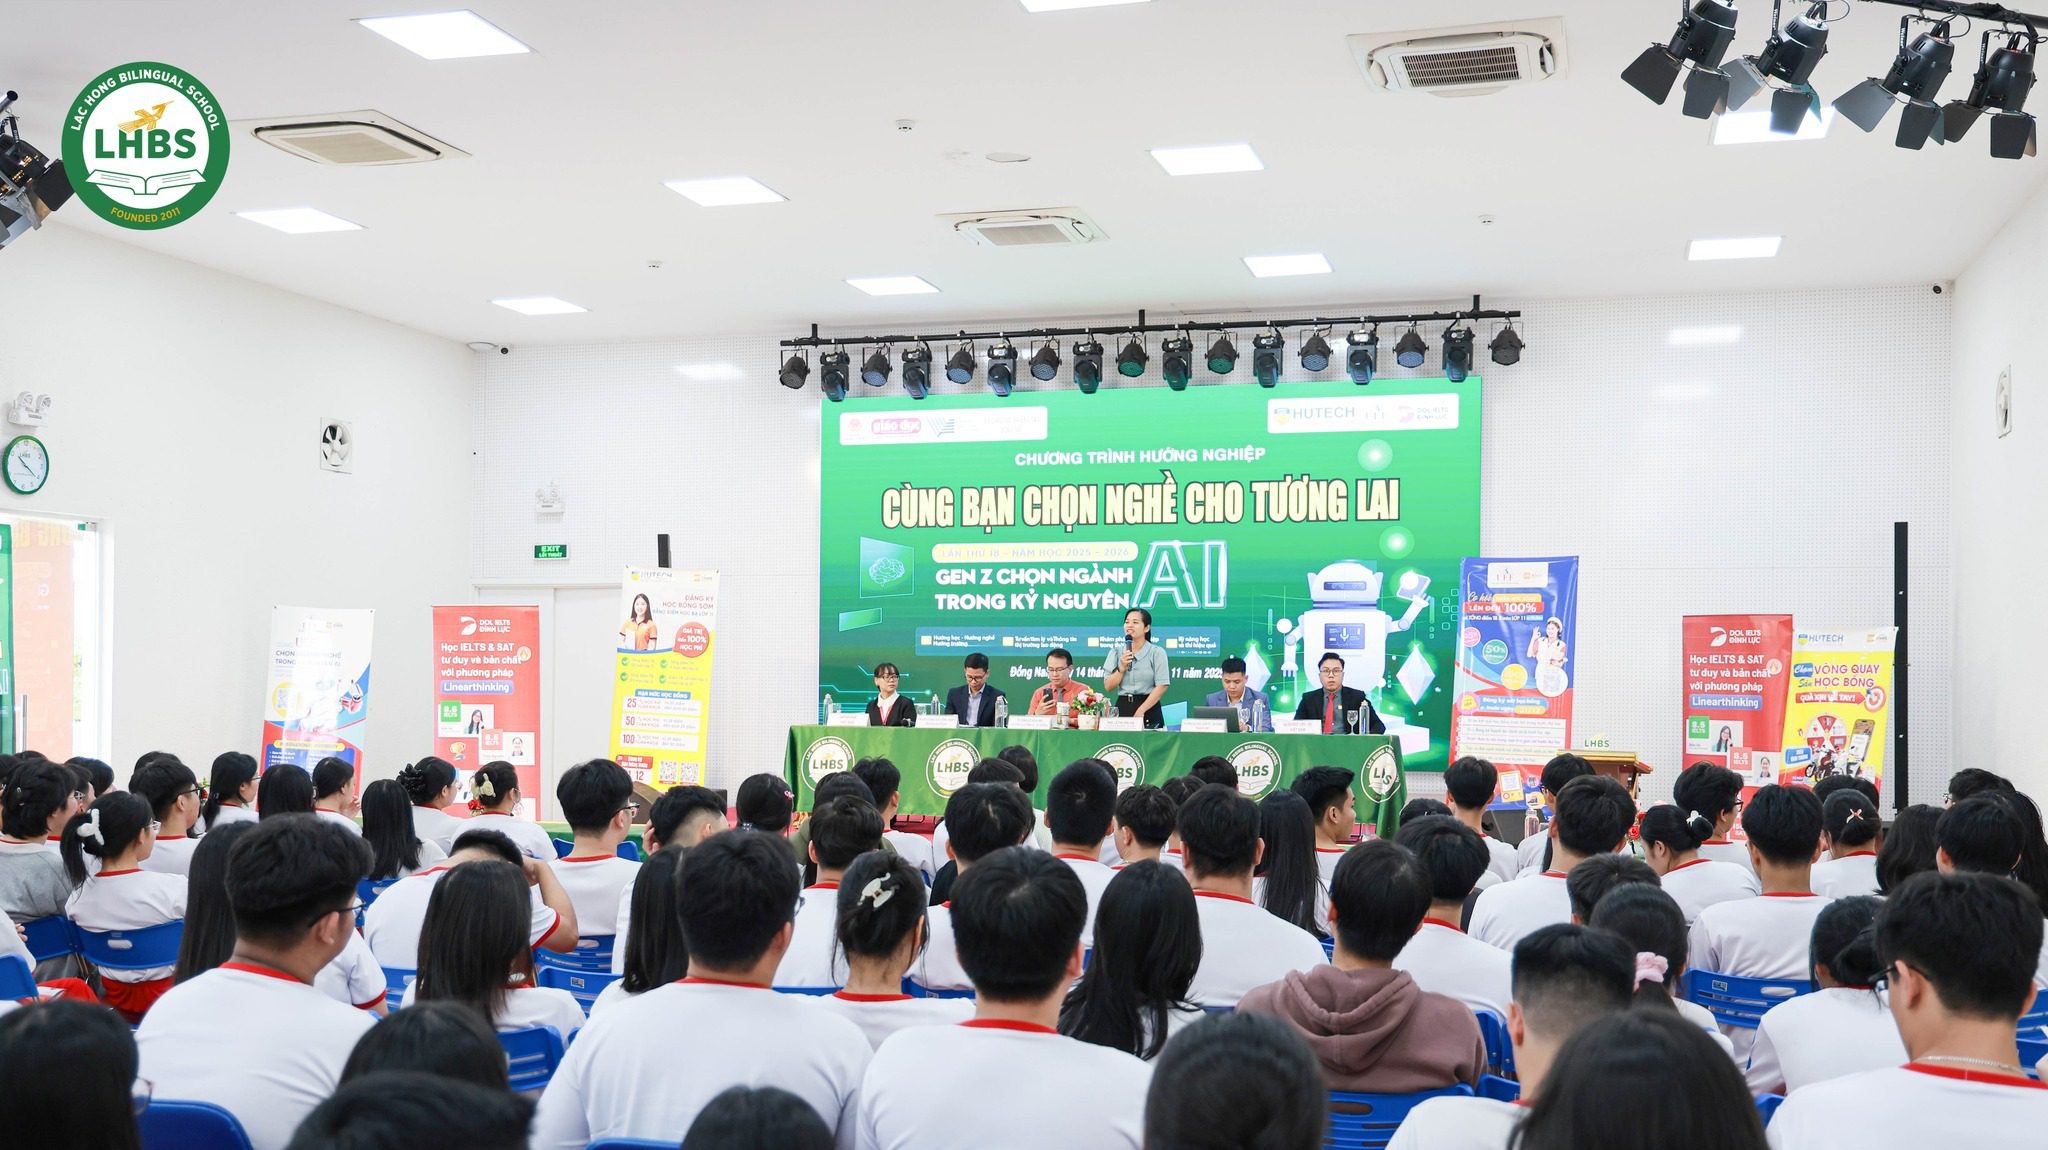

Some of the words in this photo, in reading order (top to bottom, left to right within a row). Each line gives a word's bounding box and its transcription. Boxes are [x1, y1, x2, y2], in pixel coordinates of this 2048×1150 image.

[1293, 406, 1356, 420] HUTECH
[1015, 450, 1082, 466] CHƯƠNG
[1088, 448, 1135, 464] TRÌNH
[1140, 446, 1198, 463] HƯỚNG
[1202, 444, 1266, 462] NGHIỆP
[882, 481, 954, 528] CÙNG
[961, 486, 1016, 534] BẠN
[1022, 484, 1098, 533] CHỌN
[1104, 470, 1178, 526] NGHỀ
[1184, 481, 1244, 524] CHO
[1250, 474, 1348, 523] TƯƠNG
[1356, 478, 1400, 521] LAI
[1012, 547, 1036, 557] NĂM
[1040, 548, 1062, 558] HỌC
[1066, 548, 1091, 556] 2025
[1104, 548, 1129, 556] 2026
[936, 568, 976, 585] GEN
[980, 568, 992, 584] Z
[996, 568, 1056, 586] CHỌN
[1060, 562, 1133, 584] NGÀNH
[1130, 540, 1228, 609] AI
[934, 594, 1006, 610] TRONG
[1010, 588, 1040, 610] KỶ
[1044, 588, 1130, 610] NGUYÊN
[1504, 603, 1536, 612] 100%
[1809, 634, 1844, 642] HUTECH
[441, 643, 458, 653] Học
[460, 643, 487, 651] IELTS
[488, 643, 495, 651] &
[497, 643, 514, 651] SAT
[442, 656, 451, 664] tư
[452, 656, 469, 665] duy
[471, 656, 482, 664] và
[483, 655, 500, 664] bản
[502, 655, 521, 664] chất
[1690, 655, 1707, 665] Học
[1710, 655, 1735, 663] IELTS
[1738, 655, 1745, 663] &
[1748, 655, 1764, 663] SAT
[441, 668, 454, 676] với
[456, 668, 490, 678] phương
[492, 668, 514, 678] pháp
[1010, 665, 1033, 680] Đồng
[1076, 667, 1086, 677] 14
[1172, 667, 1181, 678] 11
[1183, 667, 1202, 678] năm
[1690, 669, 1700, 677] tư
[1701, 669, 1718, 679] duy
[1720, 669, 1730, 677] và
[1733, 668, 1750, 677] bản
[1752, 669, 1771, 677] chất
[1814, 663, 1848, 674] VÒNG
[1851, 665, 1880, 674] QUAY
[444, 683, 509, 693] Linearthinking
[1690, 681, 1703, 690] với
[1705, 682, 1740, 692] phương
[1742, 682, 1763, 693] pháp
[1814, 678, 1840, 689] HỌC
[1844, 676, 1874, 687] BỔNG
[627, 698, 636, 707] 25
[1693, 696, 1758, 709] Linearthinking
[625, 716, 635, 726] 50
[623, 734, 635, 744] 100
[813, 760, 843, 769] LHBS
[937, 762, 970, 773] LHBS
[636, 771, 644, 780] 12
[1236, 765, 1269, 776] LHBS
